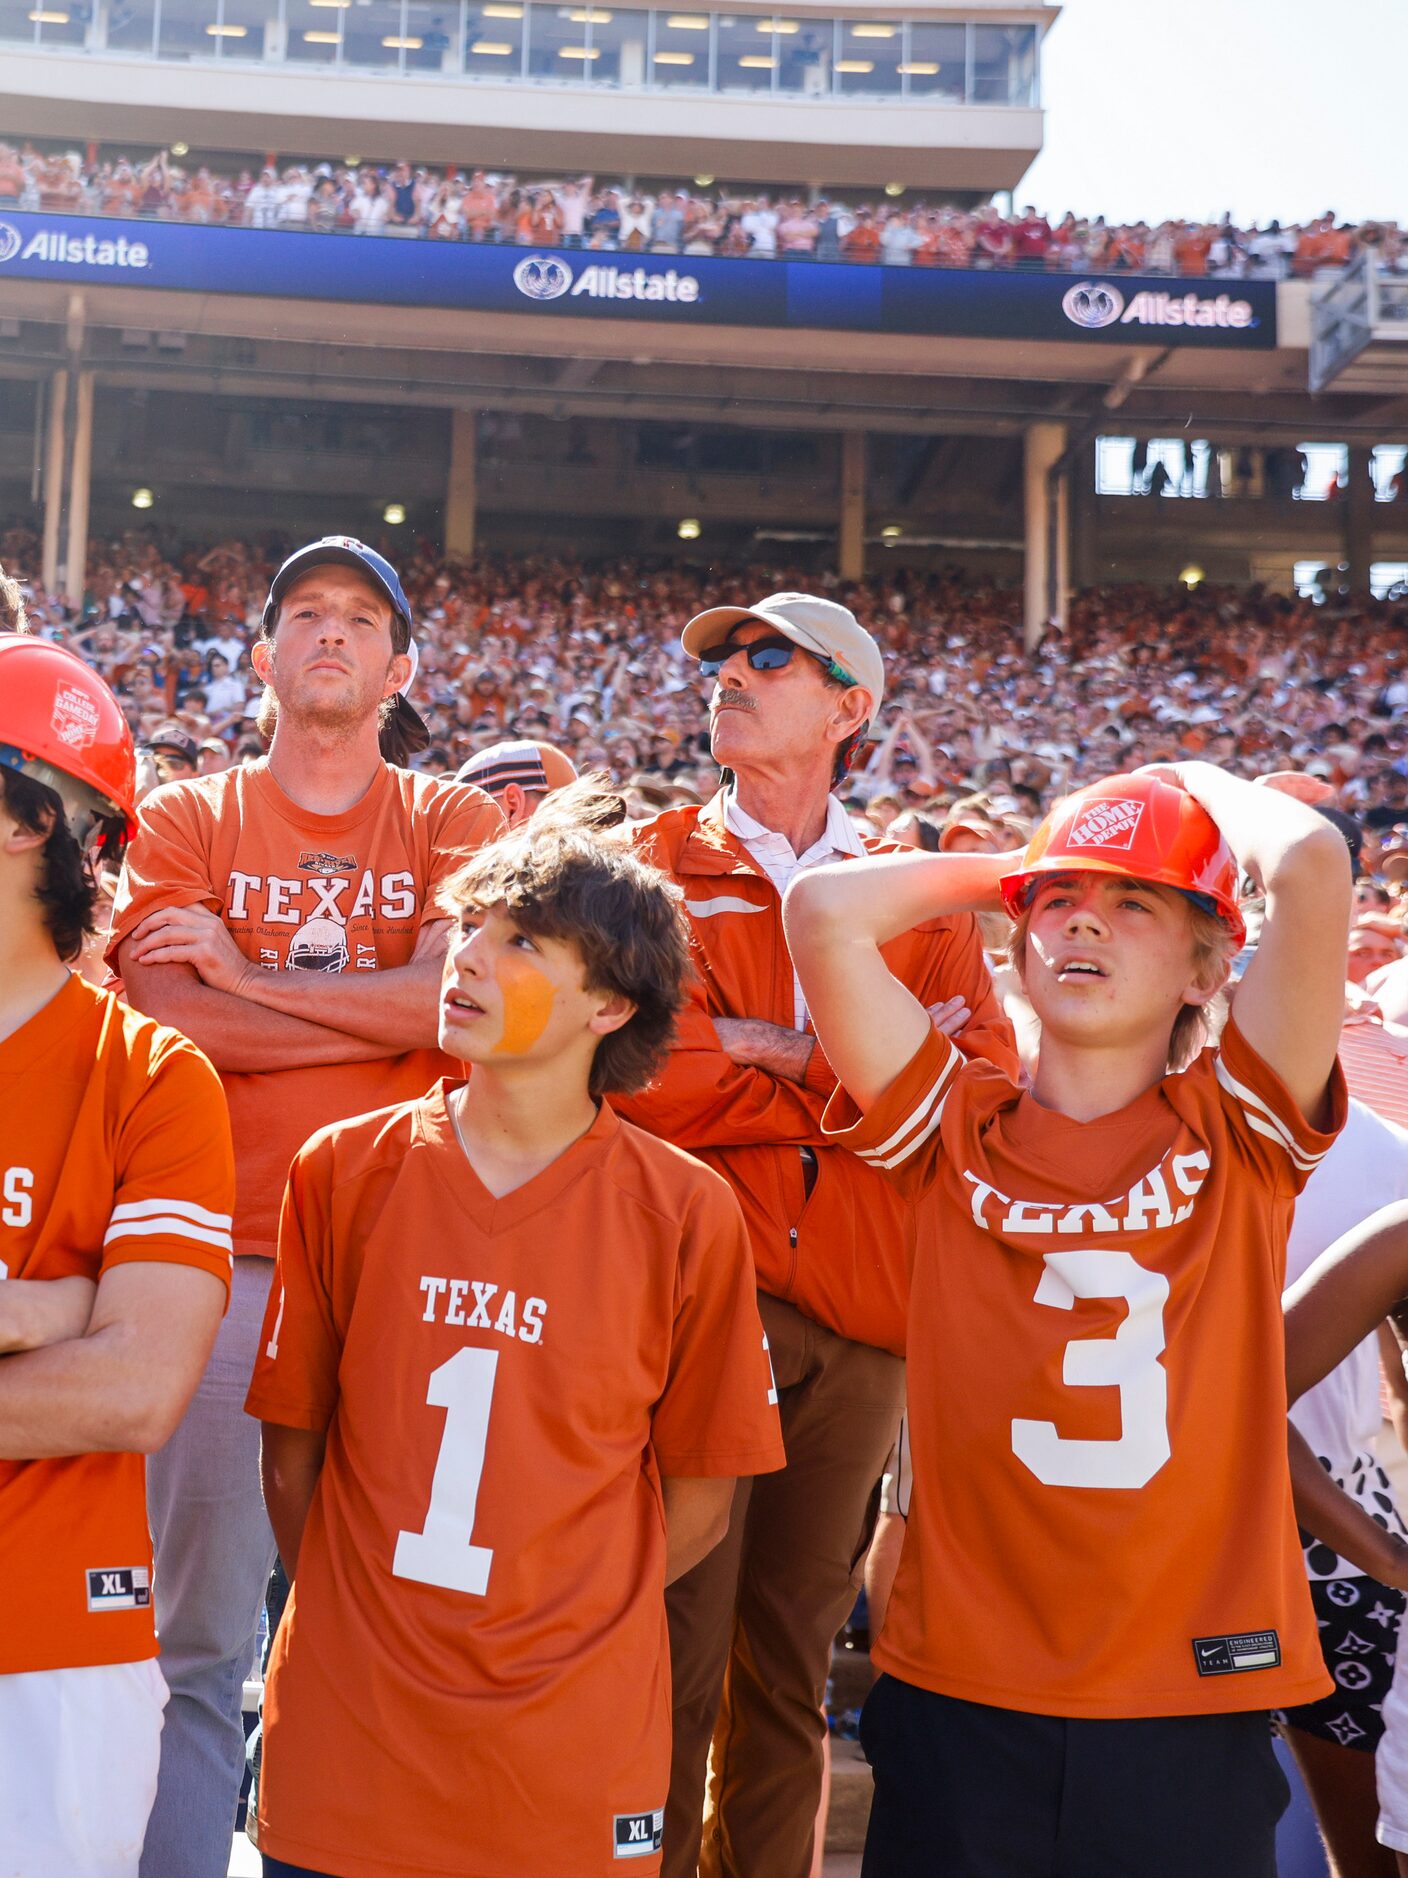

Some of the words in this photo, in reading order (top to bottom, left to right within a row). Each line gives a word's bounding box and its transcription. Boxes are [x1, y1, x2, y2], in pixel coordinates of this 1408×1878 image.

[20, 230, 150, 268] Allstate
[570, 265, 700, 302] Allstate
[1120, 291, 1253, 329] Allstate
[1071, 800, 1142, 845] HOME
[1082, 802, 1110, 821] THE
[1092, 817, 1136, 846] DEPOT
[227, 869, 416, 924] TEXAS
[419, 1275, 547, 1344] TEXAS
[1011, 1249, 1172, 1489] 3
[392, 1346, 499, 1597] 1
[100, 1573, 126, 1595] XL
[1229, 1635, 1273, 1646] ENGINEERED
[1203, 1658, 1228, 1667] TEAM
[628, 1819, 649, 1841] XL
